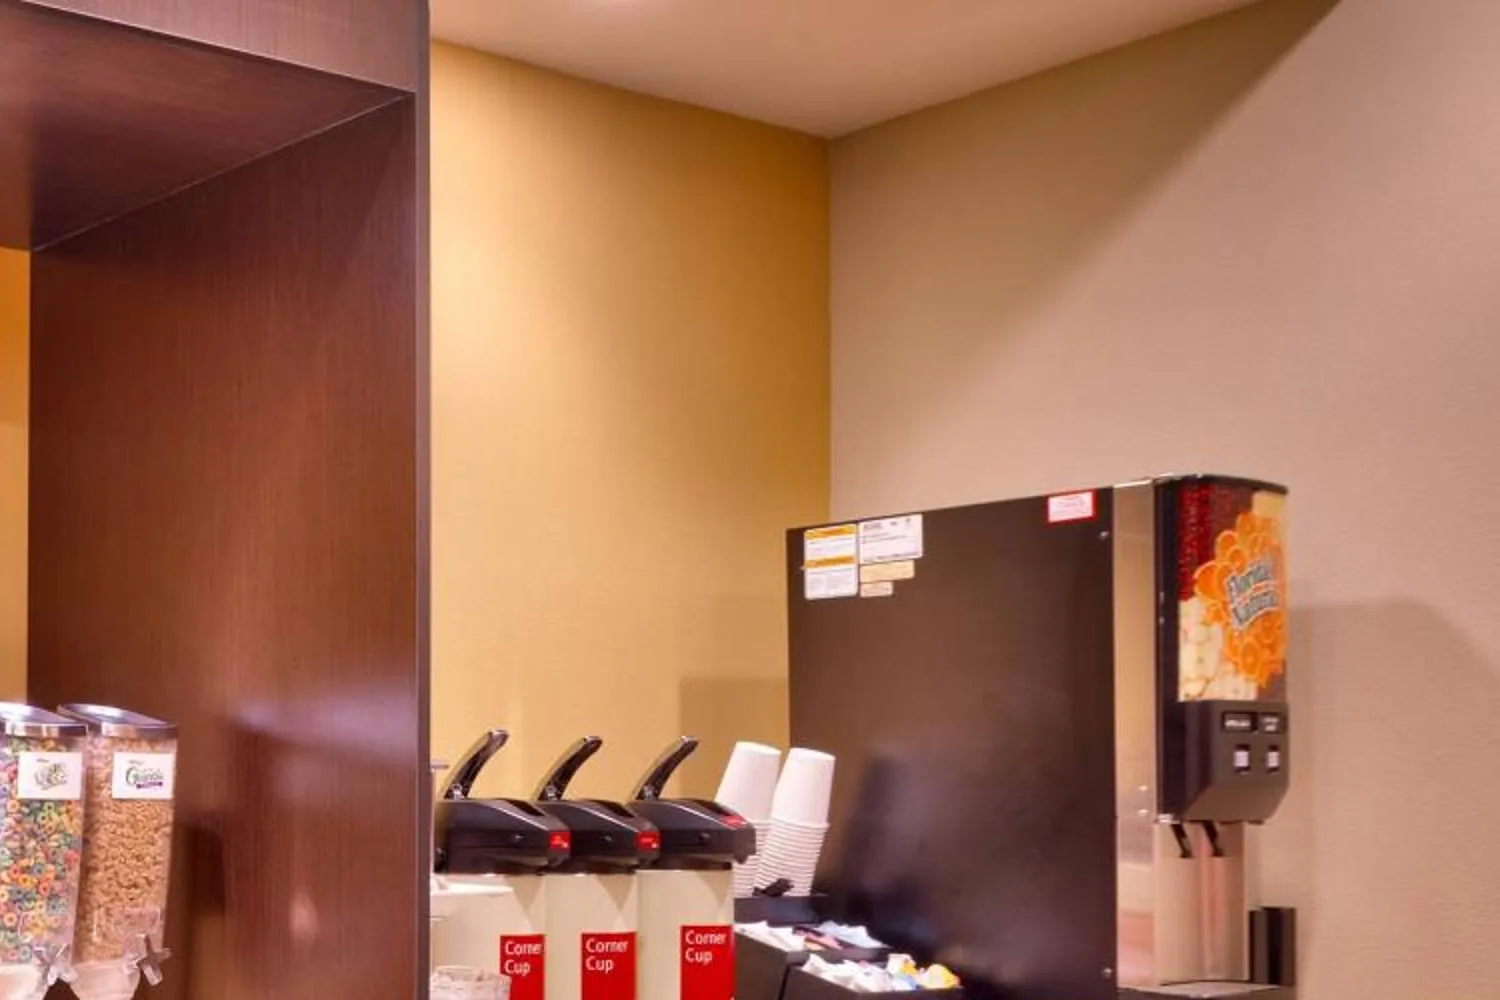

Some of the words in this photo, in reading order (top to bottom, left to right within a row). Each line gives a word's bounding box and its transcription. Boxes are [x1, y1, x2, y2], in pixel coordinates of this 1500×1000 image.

[585, 937, 628, 953] Corner
[685, 930, 726, 945] Corner
[685, 948, 713, 964] Cup
[504, 959, 531, 976] Cup
[585, 956, 614, 974] Cup
